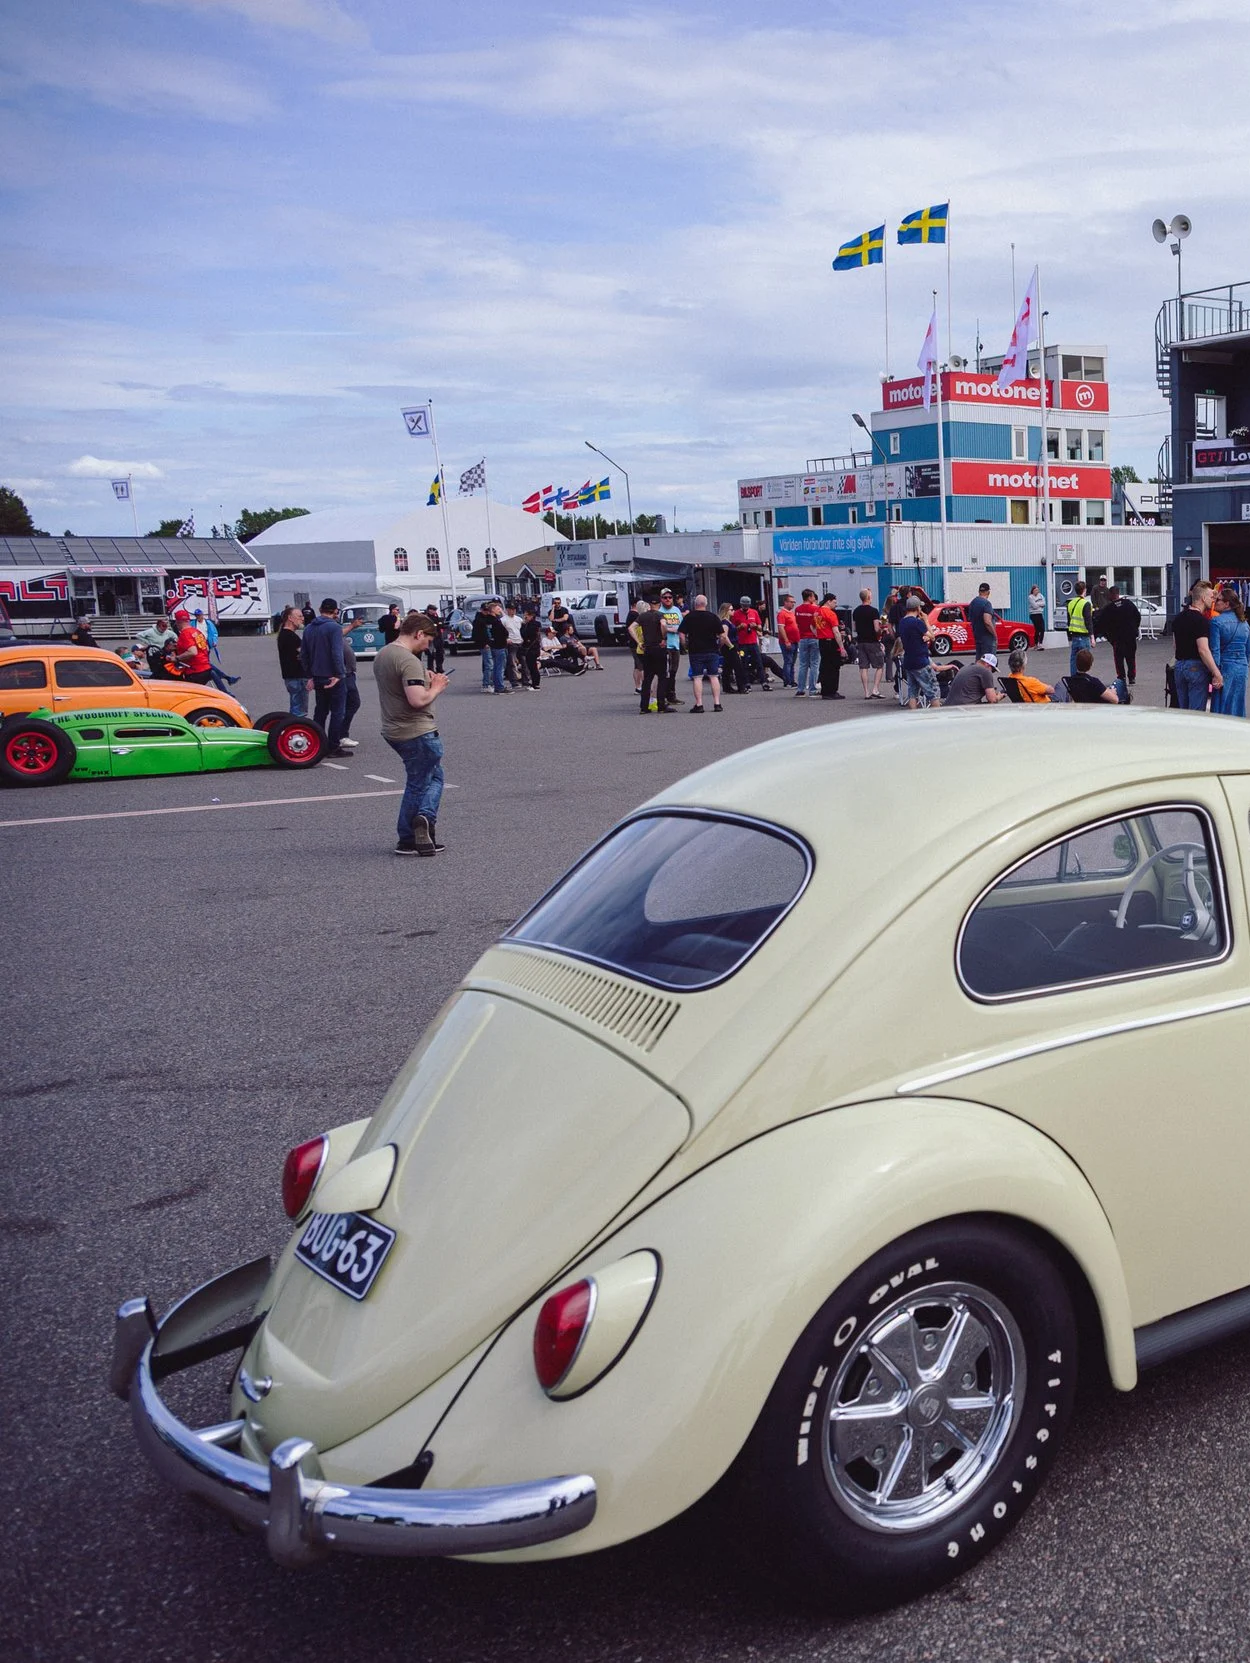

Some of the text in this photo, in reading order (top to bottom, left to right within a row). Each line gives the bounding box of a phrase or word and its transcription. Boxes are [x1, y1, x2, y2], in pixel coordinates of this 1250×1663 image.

[889, 382, 943, 403] motoe
[956, 380, 1050, 402] motonet
[1197, 451, 1223, 463] GTI
[988, 471, 1079, 490] motonet
[779, 536, 876, 553] Världen förändrar inte sig själv.
[50, 710, 174, 724] THE WOODRUFF SPECIAL
[301, 1213, 385, 1283] BUG-63
[868, 1256, 941, 1306] OVAL
